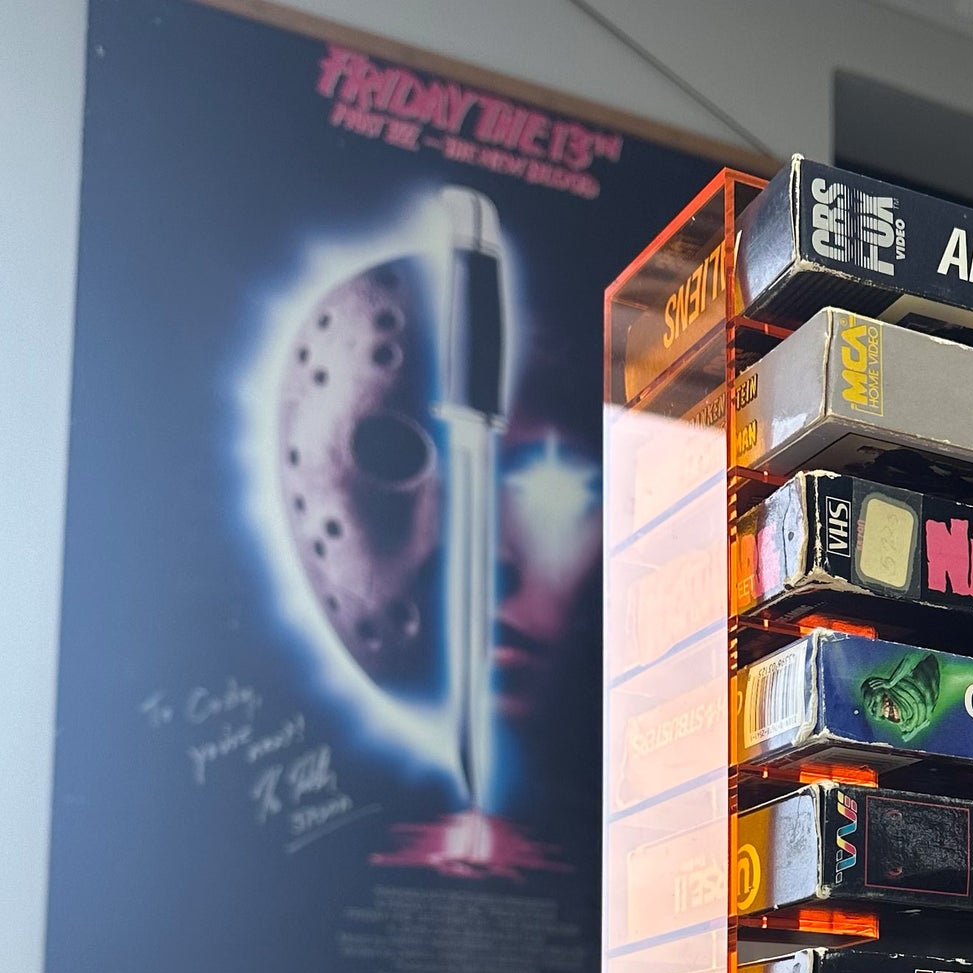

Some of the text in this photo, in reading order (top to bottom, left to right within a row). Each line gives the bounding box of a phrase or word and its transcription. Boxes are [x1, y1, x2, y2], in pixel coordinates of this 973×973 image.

[317, 43, 476, 133] FRIDAY
[472, 92, 550, 157] THE
[852, 188, 897, 277] FOX
[895, 217, 907, 261] VIDEO
[841, 324, 868, 406] MCA
[867, 326, 880, 409] HOME VIDEO
[828, 501, 850, 552] VHS
